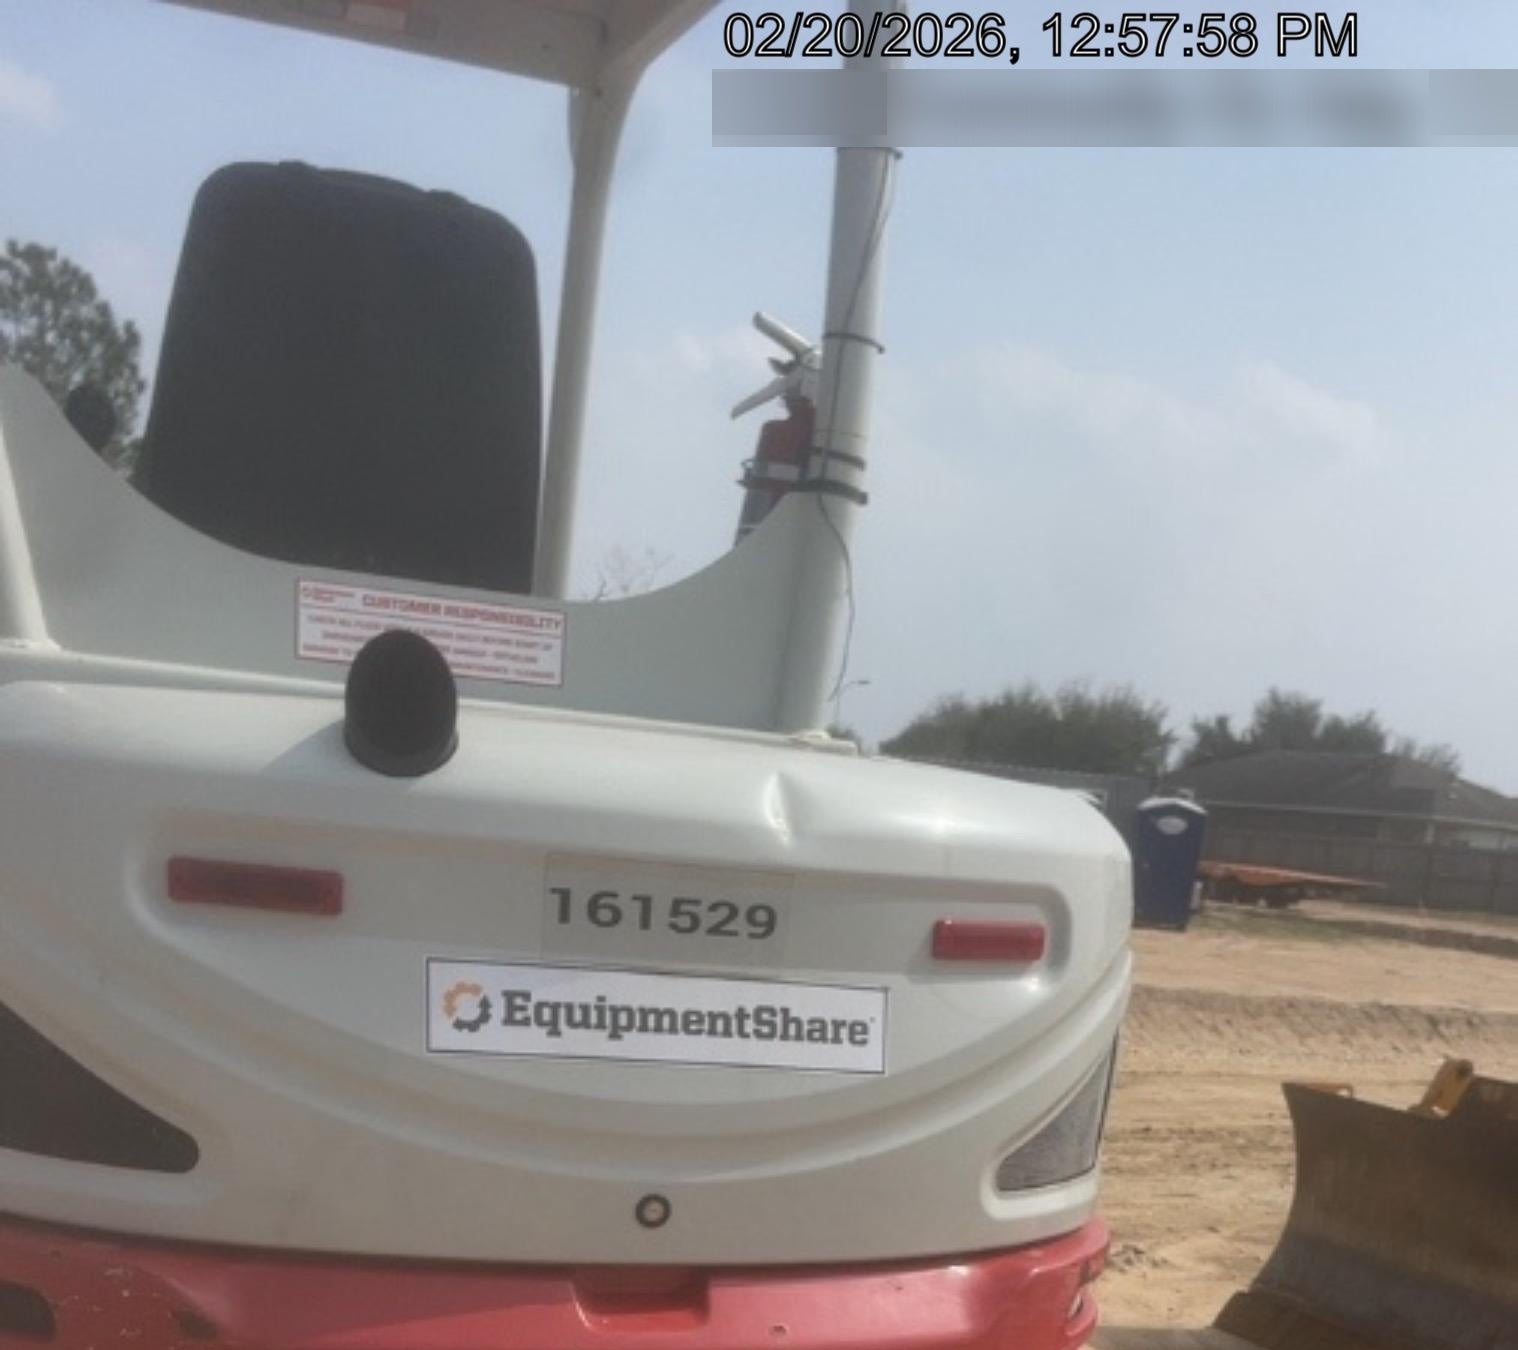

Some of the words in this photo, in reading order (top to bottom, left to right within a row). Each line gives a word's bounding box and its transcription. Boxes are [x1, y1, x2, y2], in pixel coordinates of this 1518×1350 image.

[363, 593, 442, 616] CUSTOMER
[549, 886, 778, 940] 161529
[501, 989, 871, 1047] EquipmentShare
